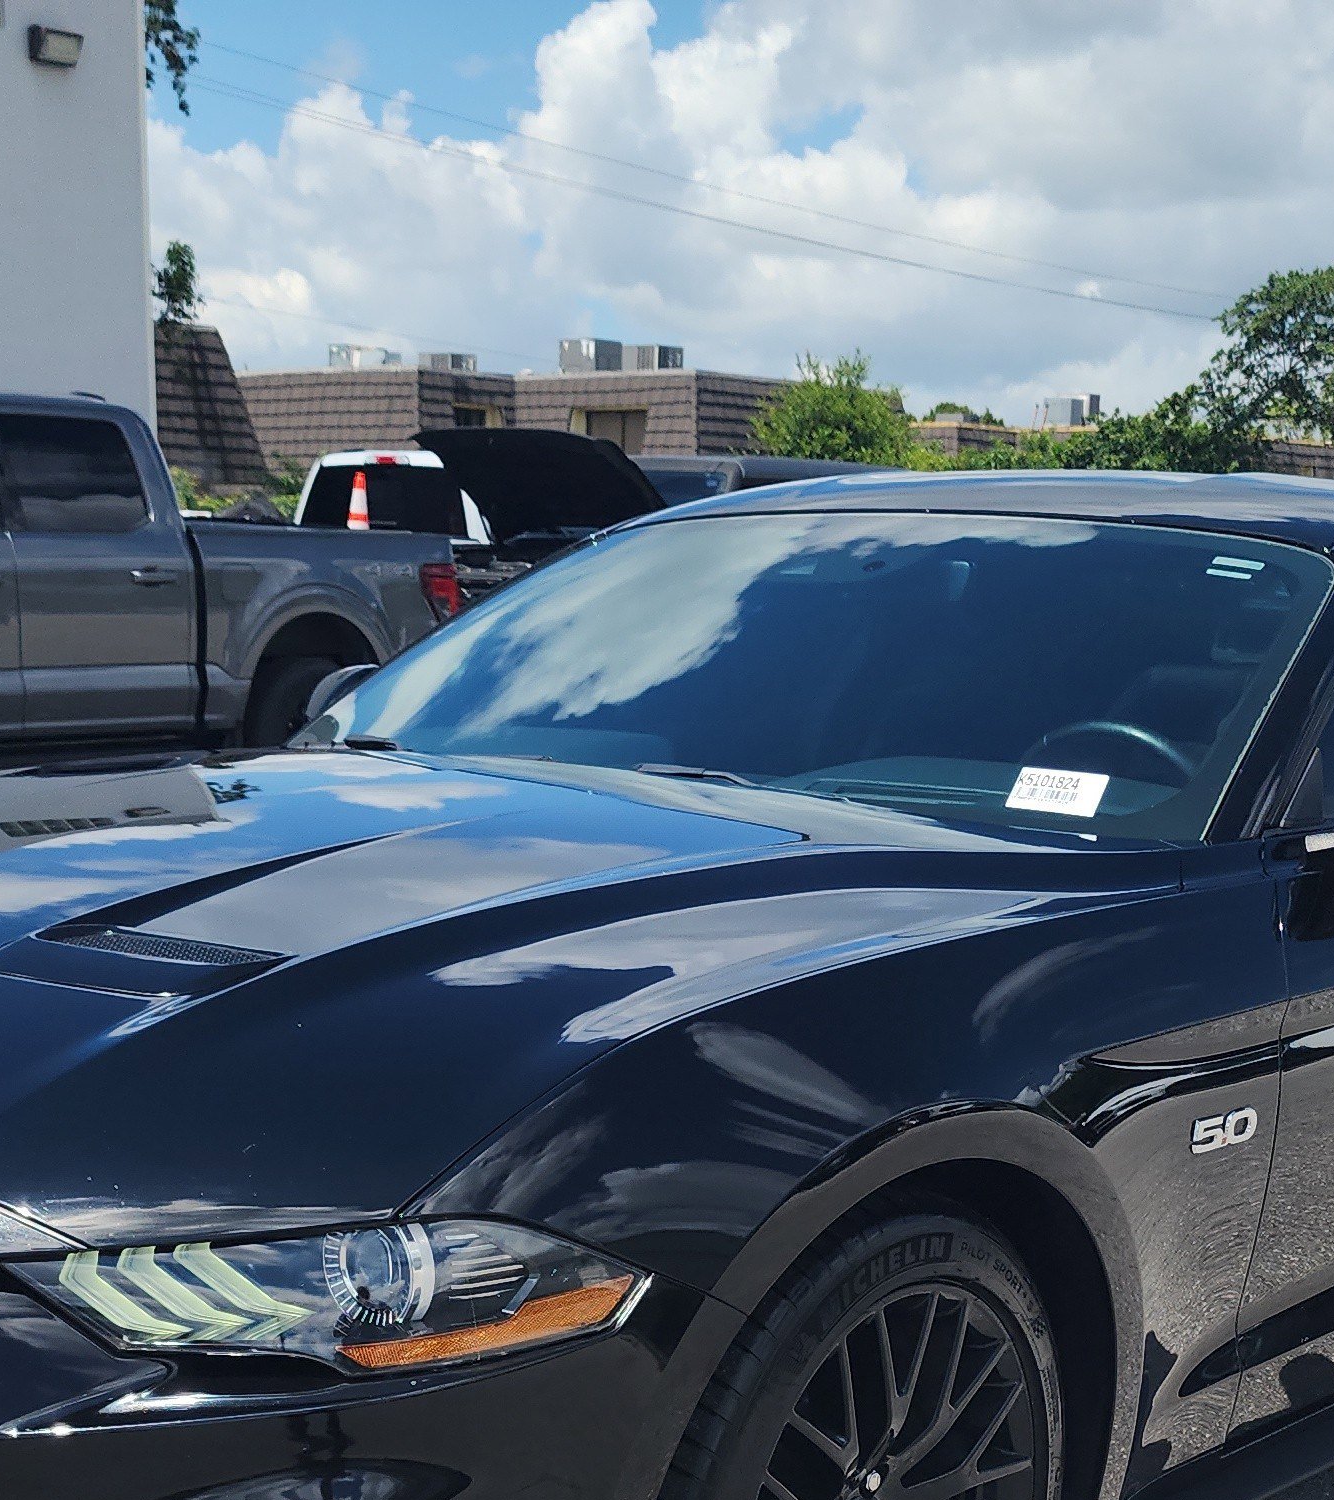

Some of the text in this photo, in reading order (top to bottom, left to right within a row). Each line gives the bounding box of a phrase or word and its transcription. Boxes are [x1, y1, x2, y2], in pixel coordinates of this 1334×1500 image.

[1017, 772, 1081, 790] K5101824
[817, 1235, 947, 1331] MICHELIN
[960, 1239, 1023, 1293] PILOT SPORT
